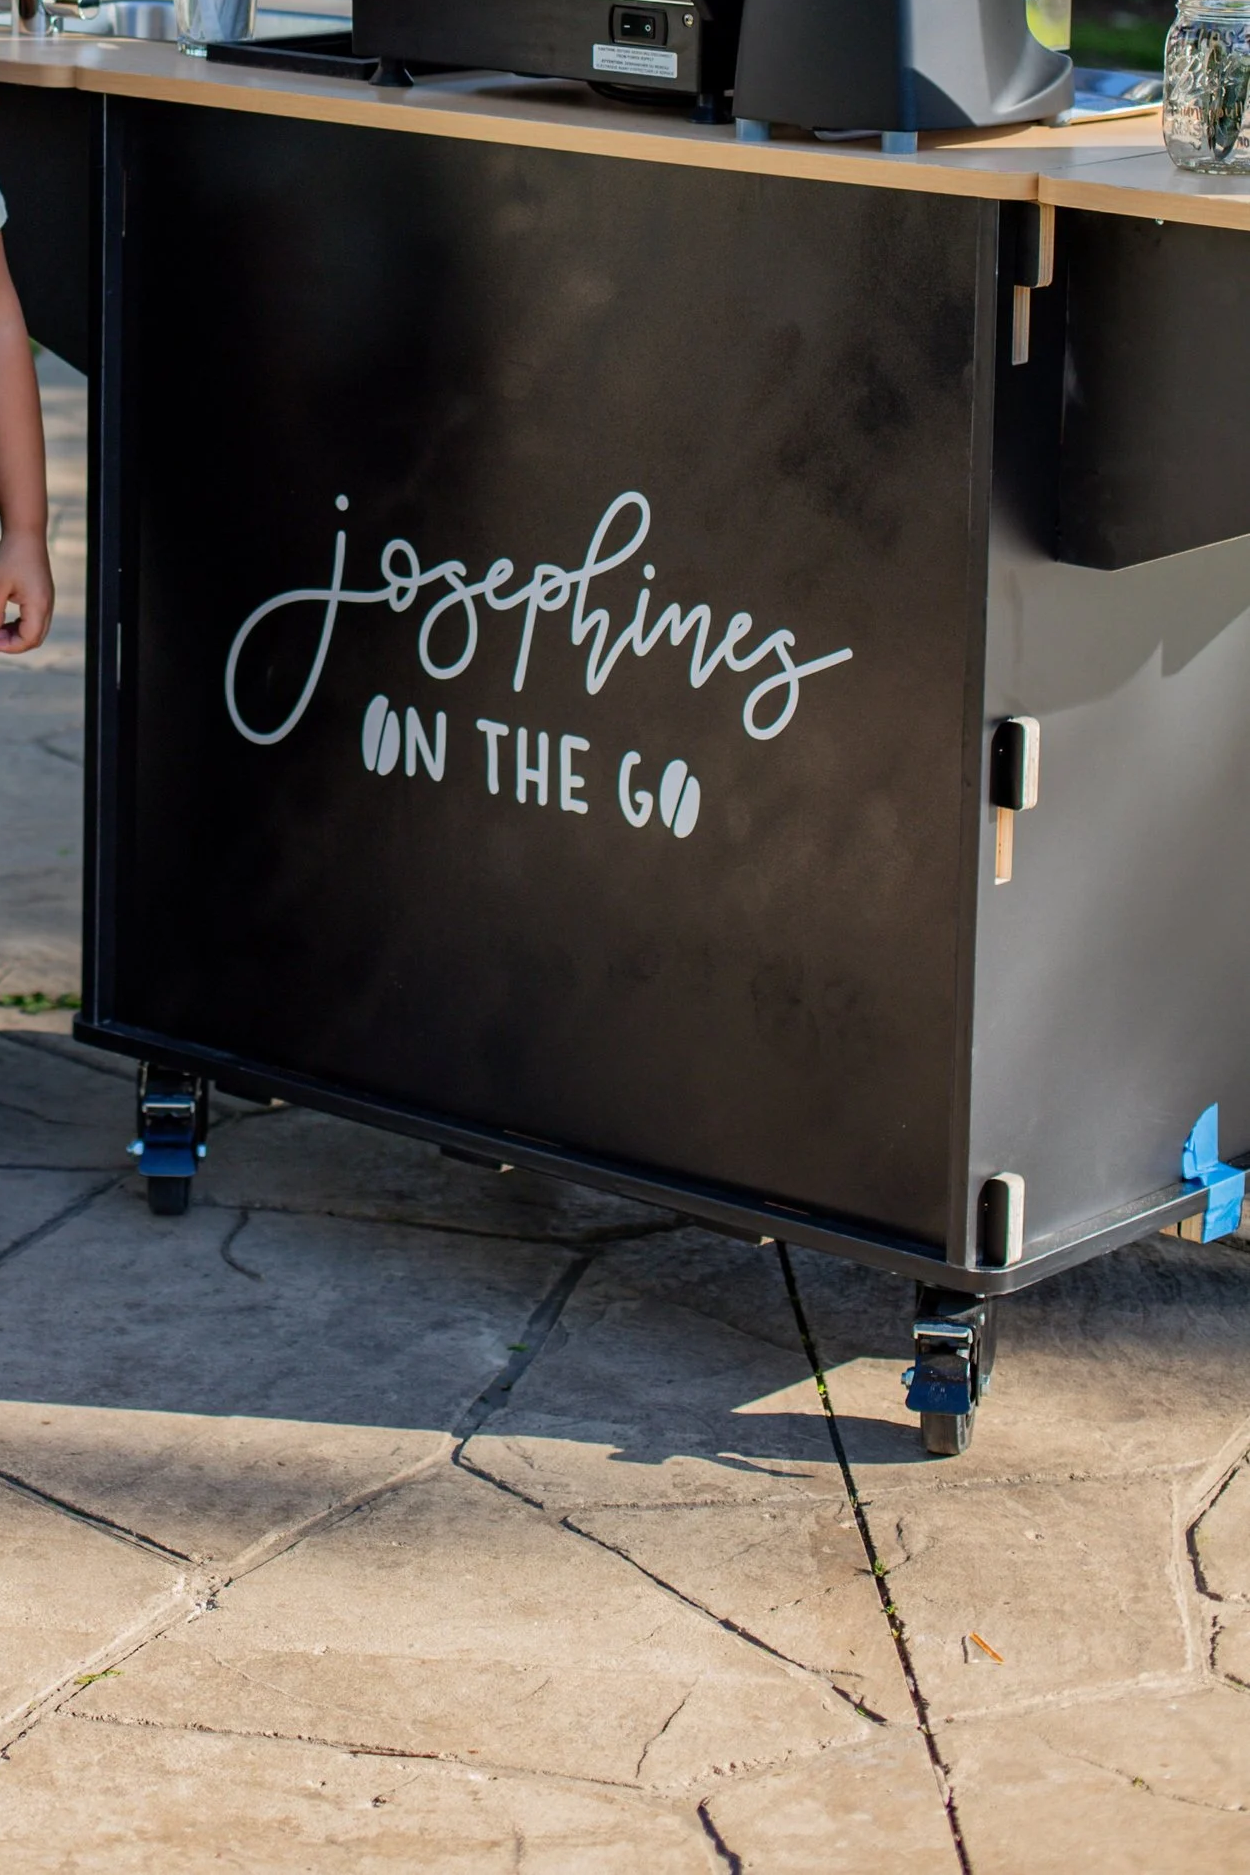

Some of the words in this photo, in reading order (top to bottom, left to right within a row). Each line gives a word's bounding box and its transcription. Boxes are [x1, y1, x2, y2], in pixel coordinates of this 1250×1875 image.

[226, 491, 854, 745] josephines
[362, 695, 447, 782] ON
[476, 718, 591, 815] THE
[618, 750, 701, 839] GO
